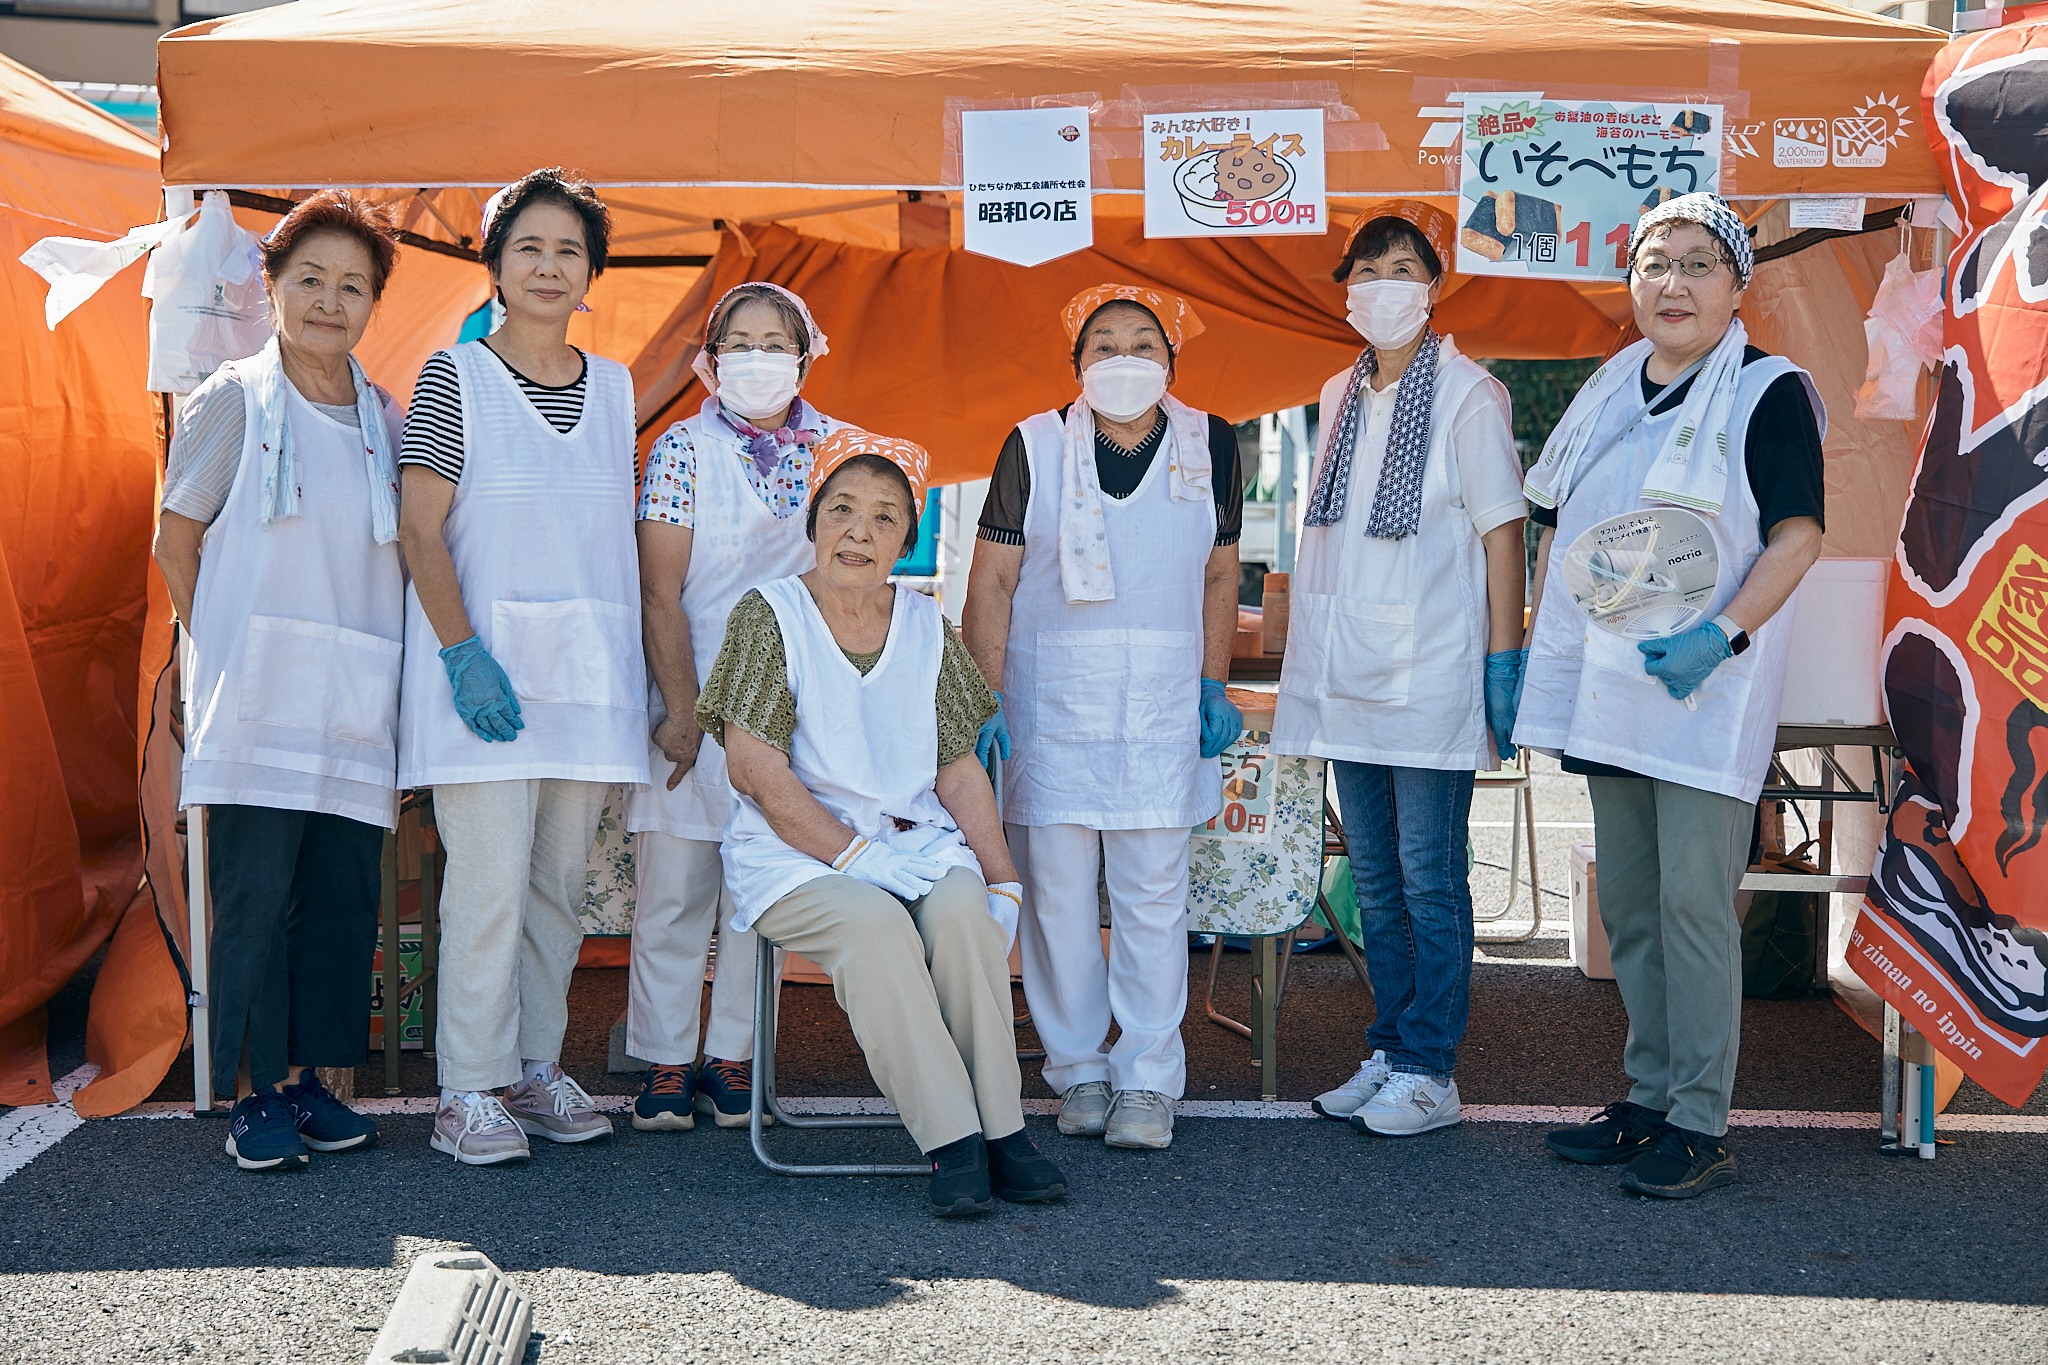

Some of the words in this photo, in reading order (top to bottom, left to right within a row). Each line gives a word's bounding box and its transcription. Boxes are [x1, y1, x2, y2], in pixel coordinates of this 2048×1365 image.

[1477, 111, 1524, 138] 絶品
[1554, 110, 1662, 126] お醤油の香ばしさと
[1159, 132, 1306, 162] カレーライス
[1778, 146, 1825, 159] 2,000mm
[1836, 139, 1870, 157] UV
[1478, 140, 1705, 192] いそべもち
[969, 179, 1086, 192] ひたちなか商工会議所女性会
[978, 199, 1077, 224] 昭和の店
[1225, 199, 1316, 226] 500円
[1513, 232, 1557, 263] 1個
[1667, 548, 1702, 566] nocria
[1862, 943, 1913, 990] ziman
[1911, 988, 1938, 1013] no
[1936, 1011, 1983, 1060] ippin
